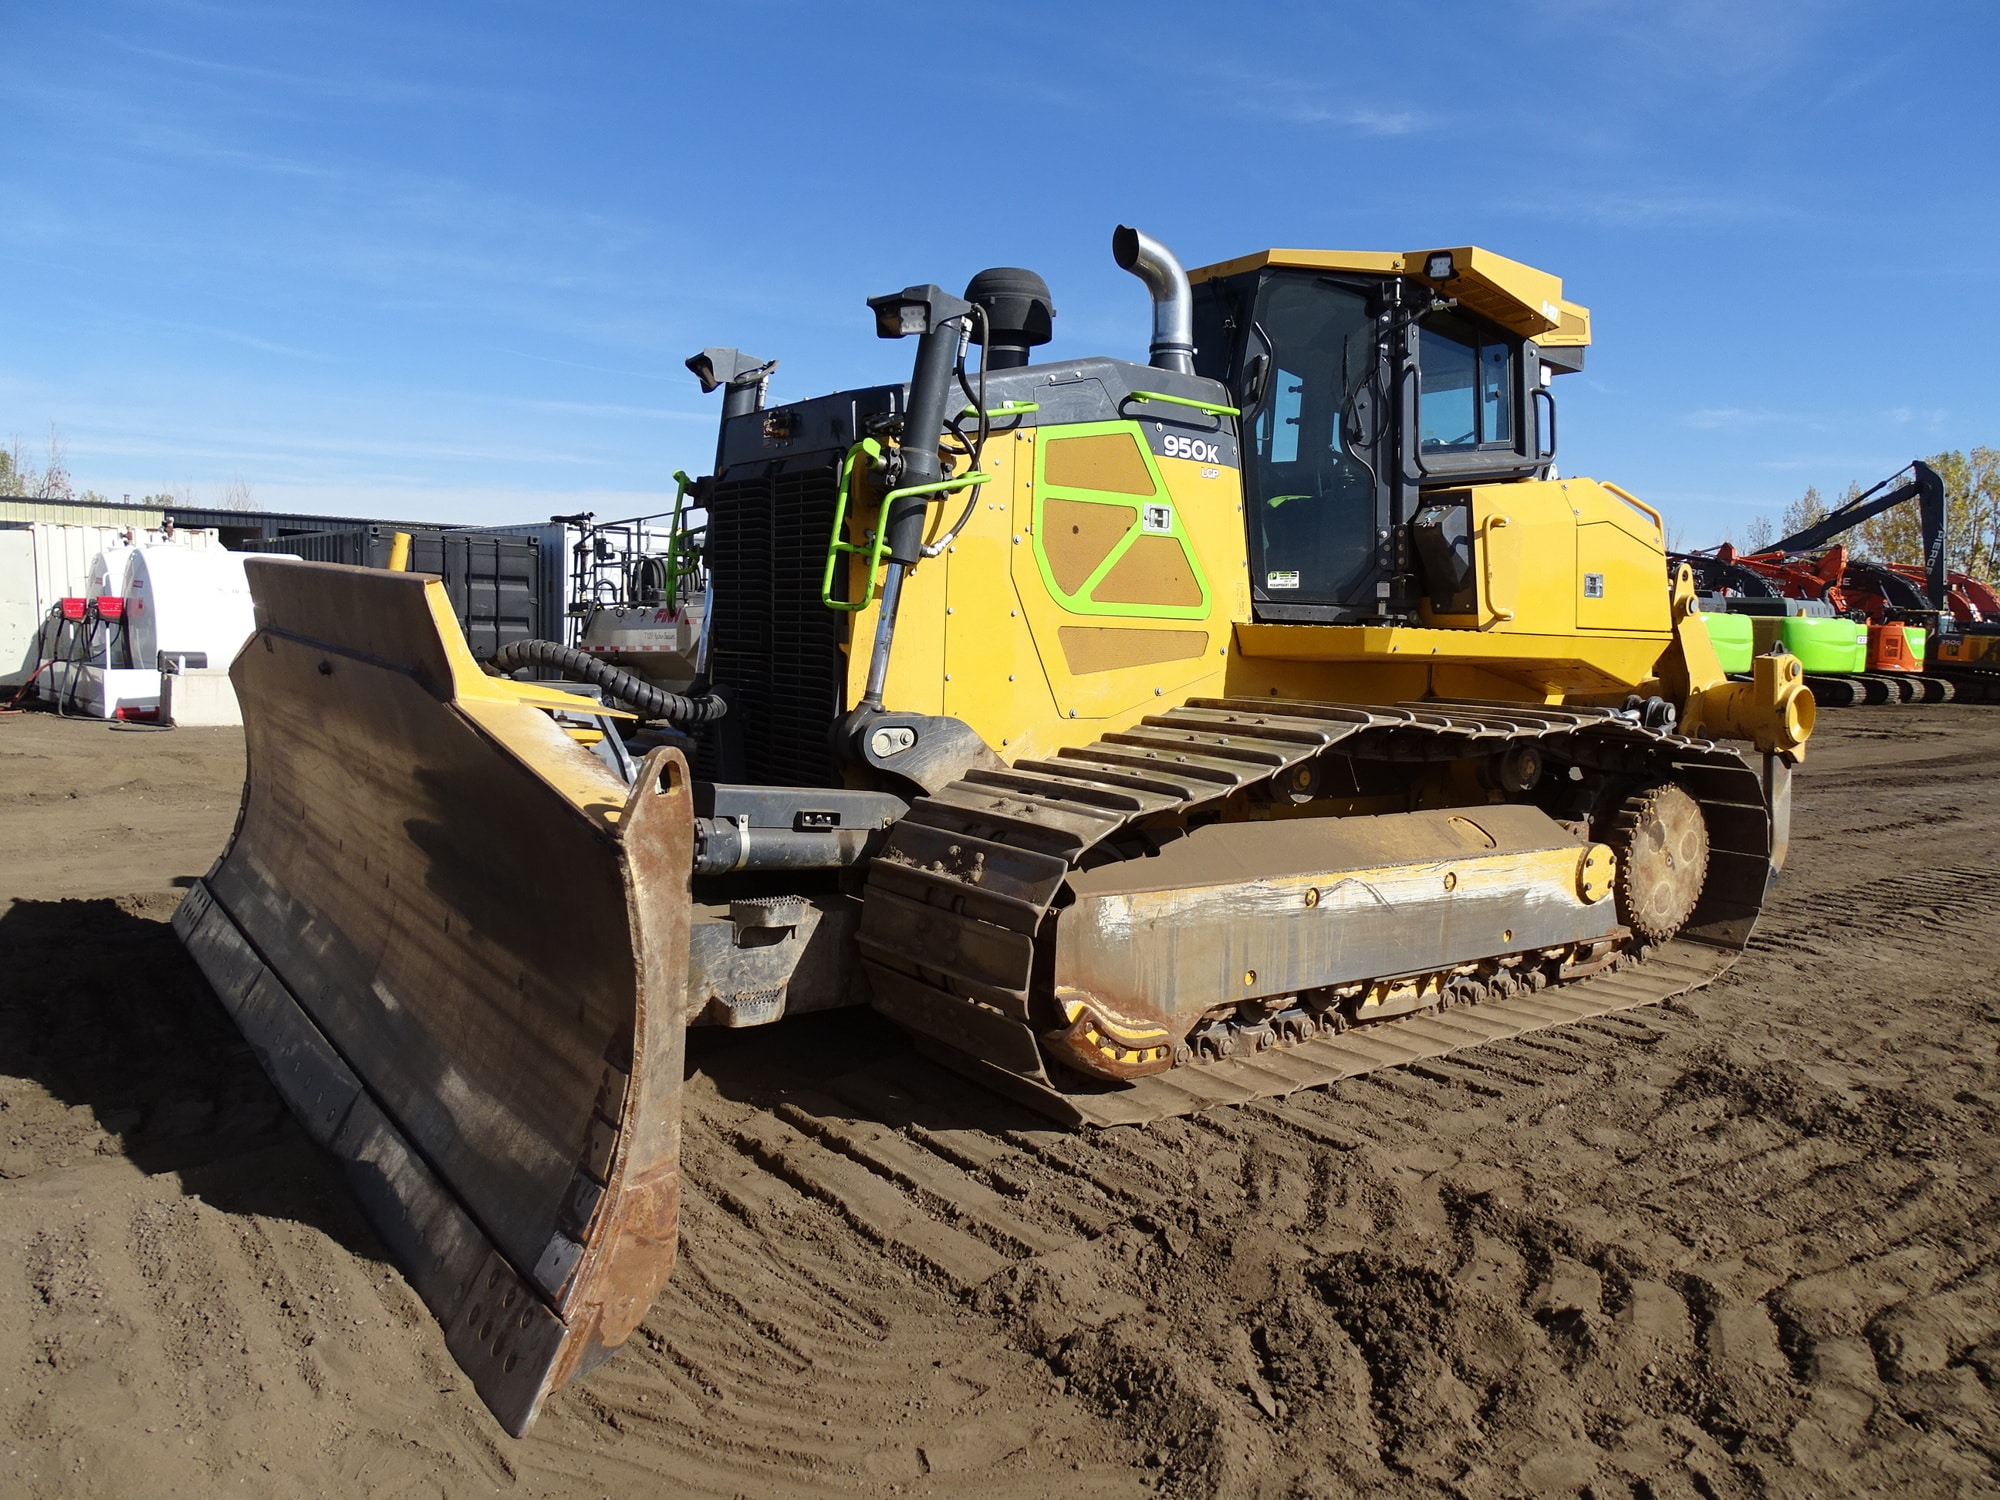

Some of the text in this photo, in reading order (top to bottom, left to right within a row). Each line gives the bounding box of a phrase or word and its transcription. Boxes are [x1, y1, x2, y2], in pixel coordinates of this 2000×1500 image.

[1163, 435, 1220, 464] 950K
[1201, 467, 1219, 479] LGP
[1925, 530, 1944, 576] PIERCE
